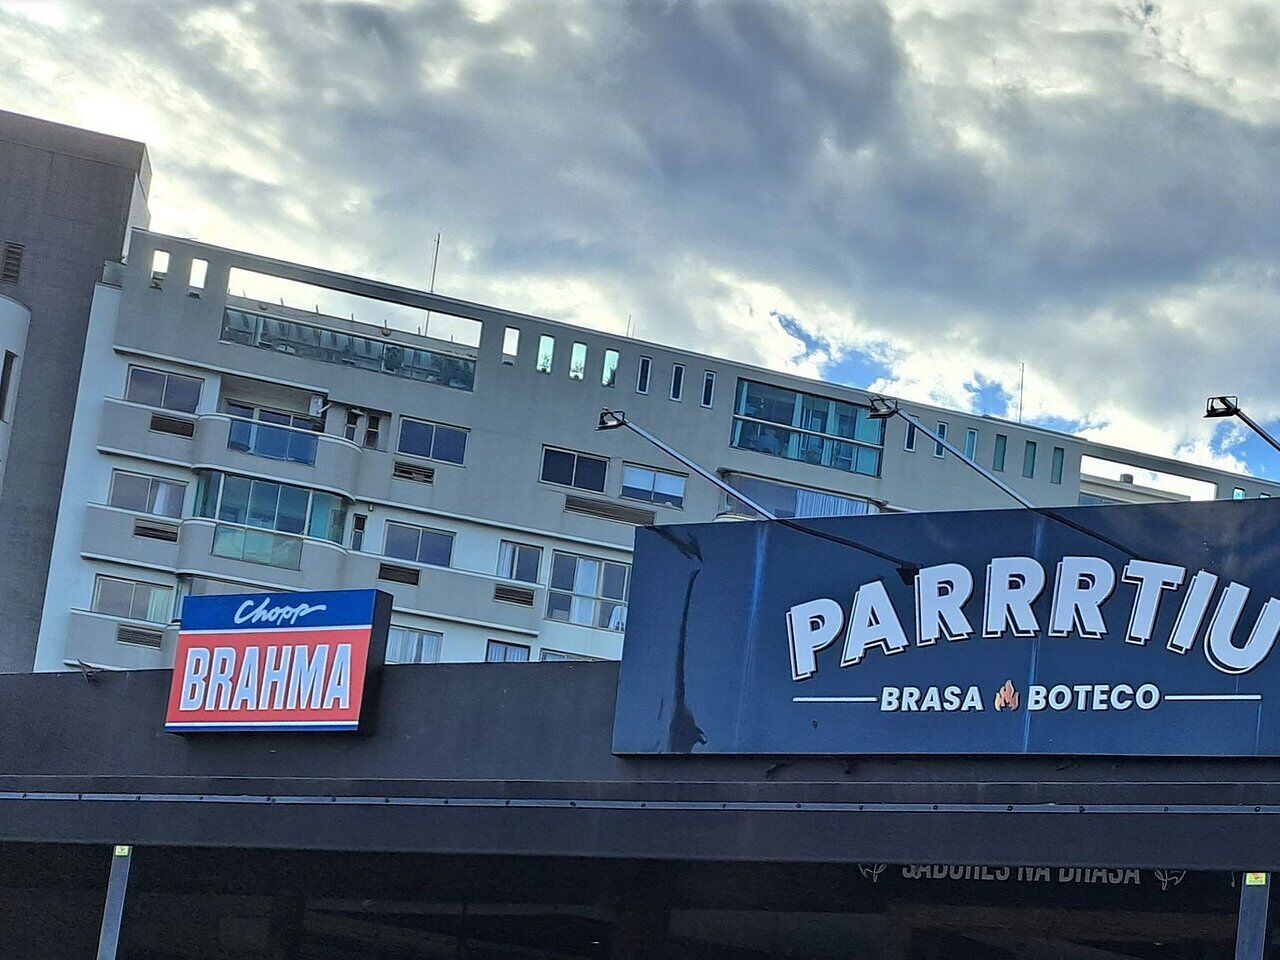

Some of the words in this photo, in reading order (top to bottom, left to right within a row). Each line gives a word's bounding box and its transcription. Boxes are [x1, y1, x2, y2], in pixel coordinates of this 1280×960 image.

[234, 597, 327, 626] Chopp
[178, 643, 352, 711] BRAHMA
[879, 685, 985, 713] BRASA
[1026, 683, 1161, 711] BOTECO
